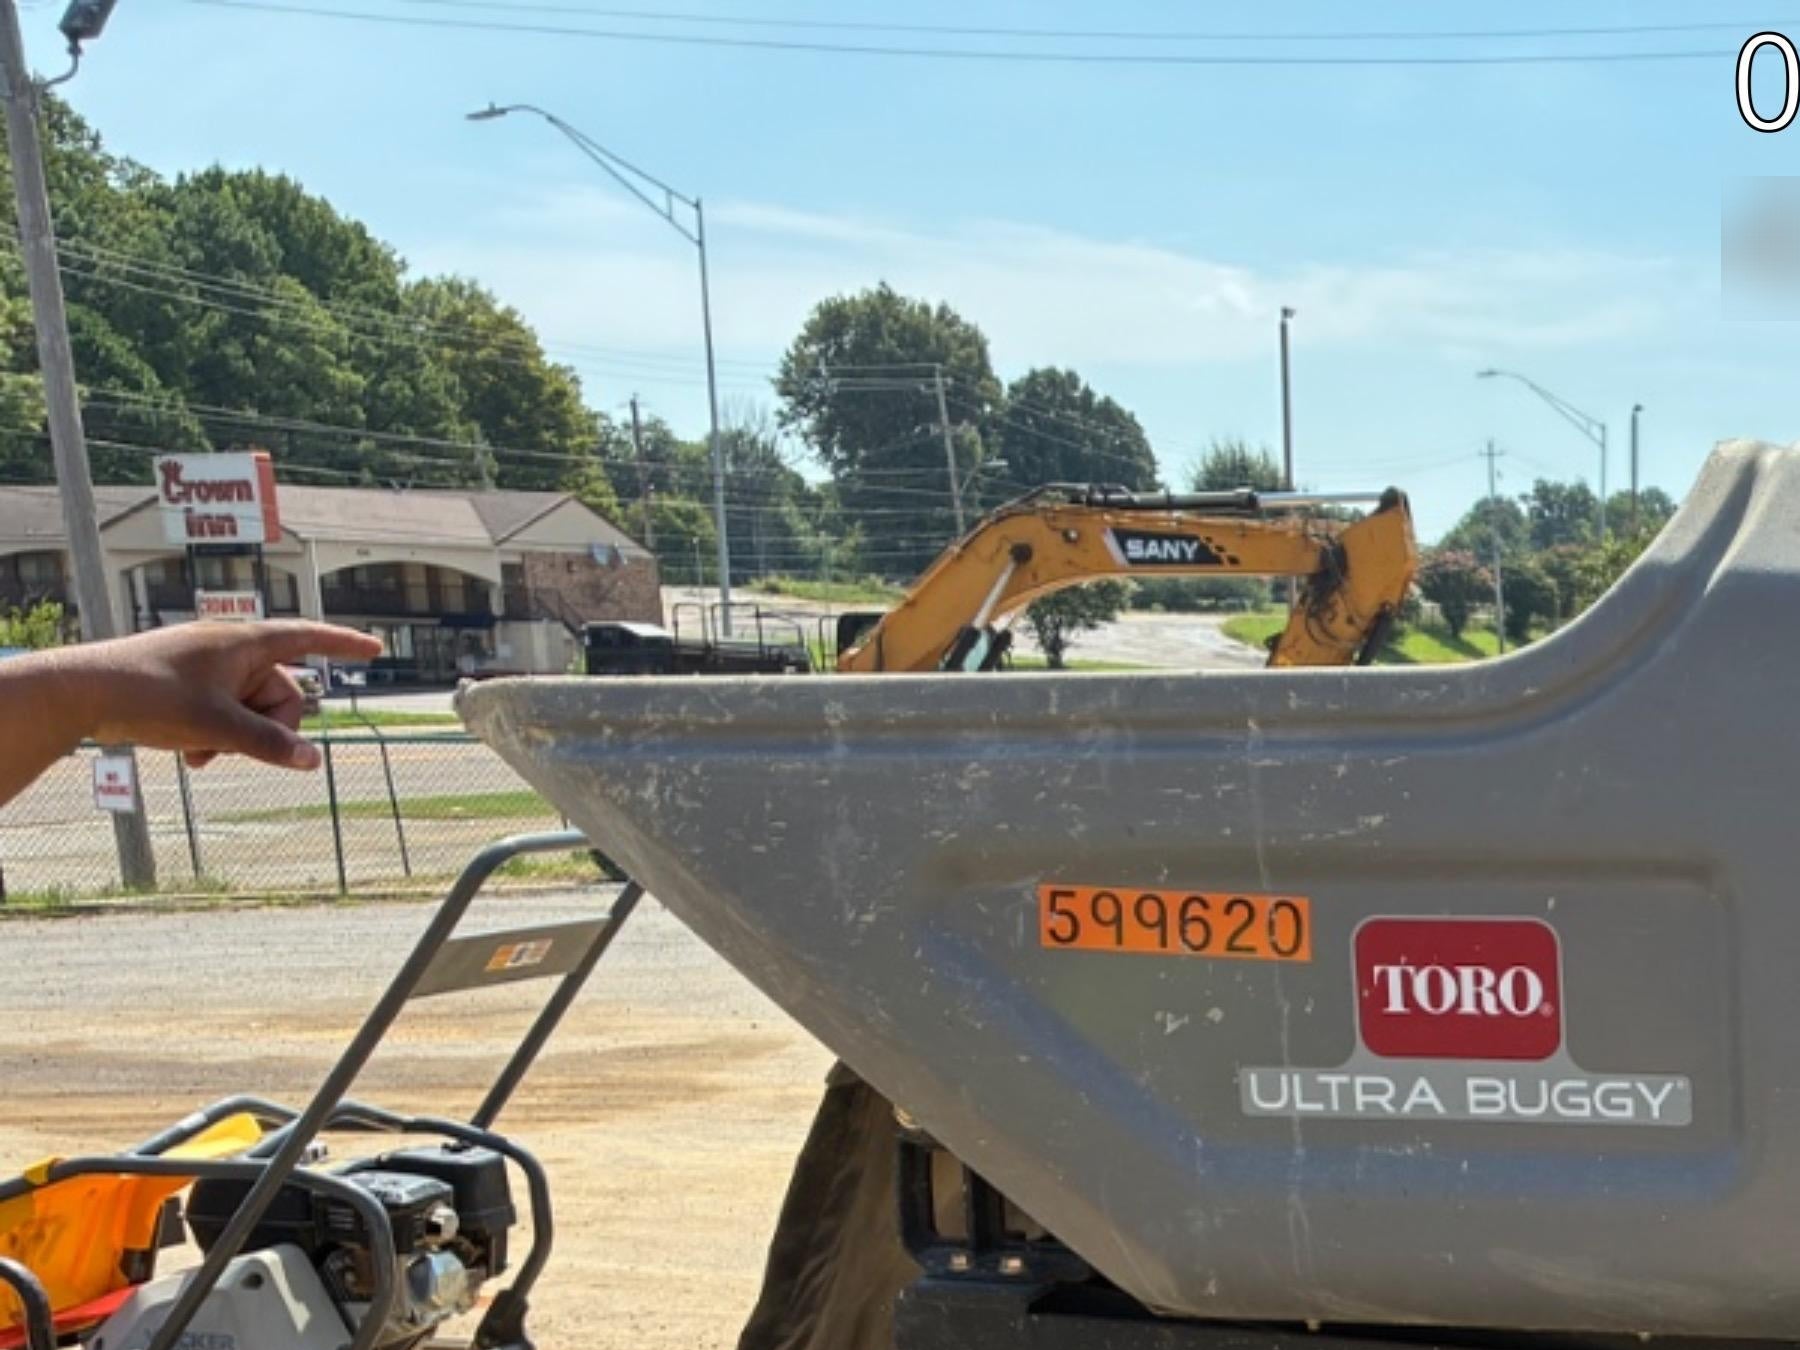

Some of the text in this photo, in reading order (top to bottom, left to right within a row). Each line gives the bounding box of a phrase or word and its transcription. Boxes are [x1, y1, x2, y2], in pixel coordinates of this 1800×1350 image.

[162, 472, 254, 504] Crown
[1126, 538, 1198, 560] SANY
[1046, 889, 1303, 958] 599620
[1249, 1074, 1445, 1115] ULTRA
